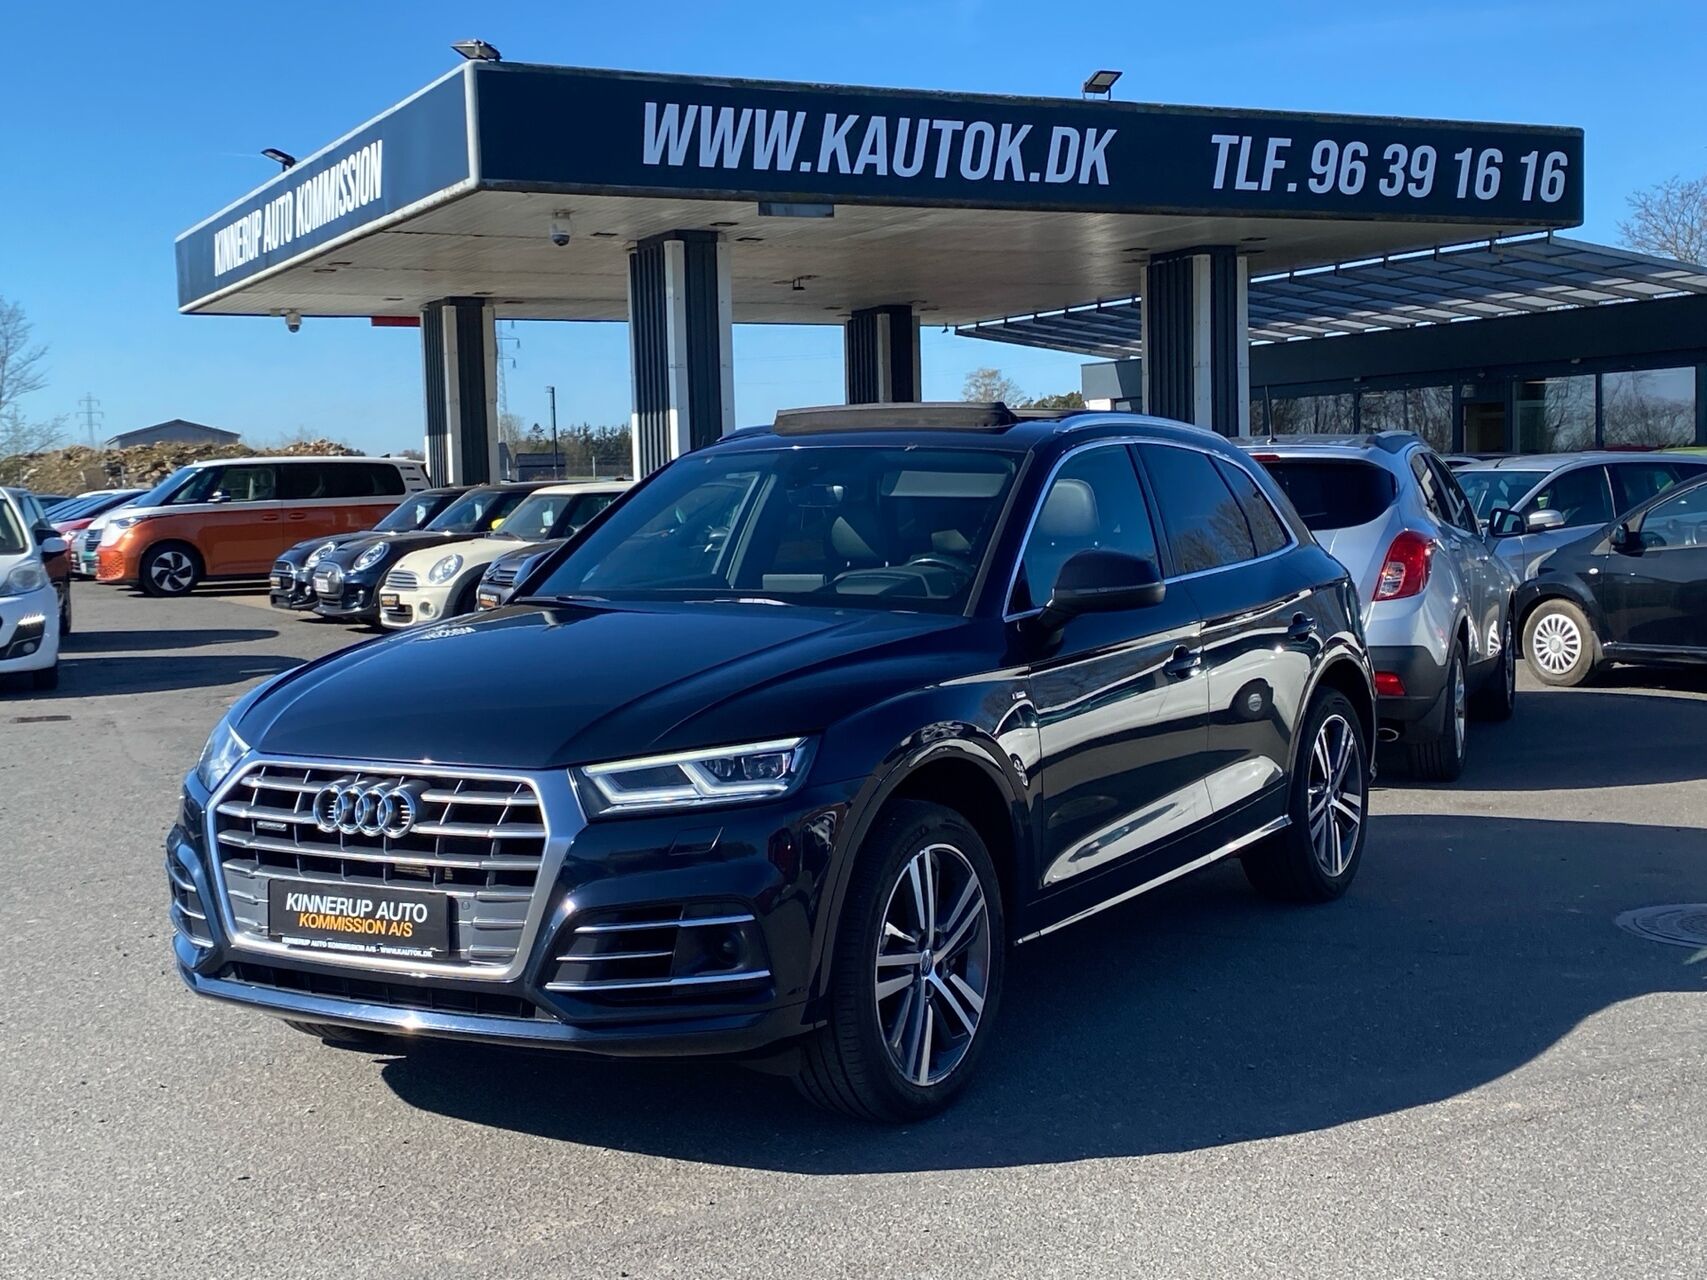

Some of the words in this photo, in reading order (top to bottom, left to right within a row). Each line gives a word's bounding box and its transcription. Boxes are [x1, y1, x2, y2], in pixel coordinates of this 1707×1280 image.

[643, 101, 1118, 186] WWW.KAUTOK.DK
[1211, 134, 1297, 192] TLF.
[1308, 139, 1369, 195] 96
[1378, 143, 1437, 198] 39
[1454, 147, 1503, 200] 16
[1520, 150, 1568, 203] 16
[214, 209, 263, 277] KINNERUP
[263, 191, 294, 253] AUTO
[295, 139, 383, 238] KOMMISSION
[285, 892, 373, 918] KINNERUP
[375, 901, 428, 923] AUTO
[299, 913, 386, 935] KOMMISSION
[388, 922, 413, 937] A/S
